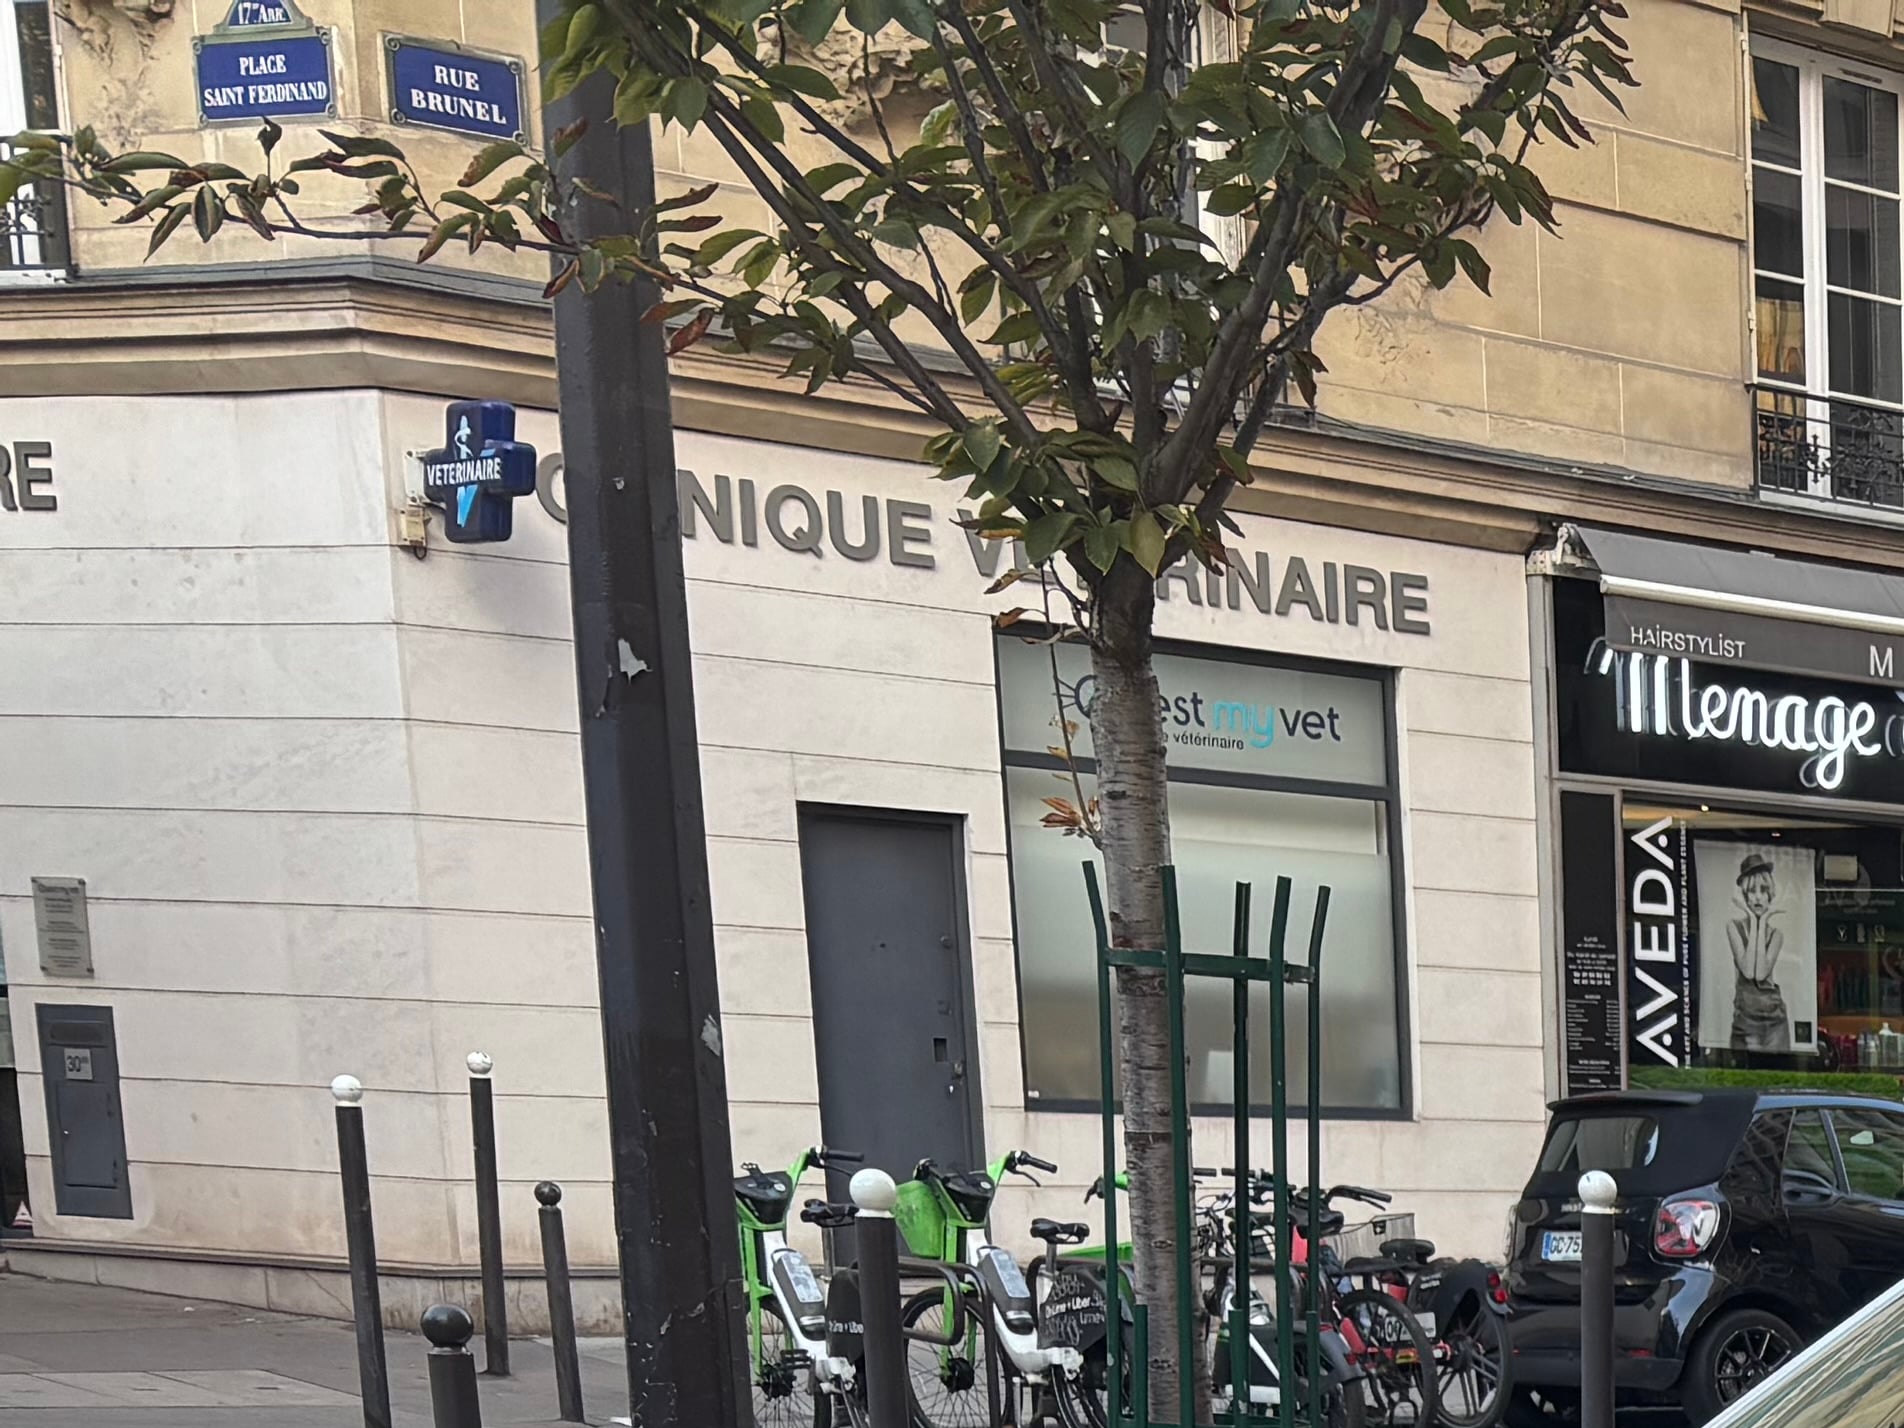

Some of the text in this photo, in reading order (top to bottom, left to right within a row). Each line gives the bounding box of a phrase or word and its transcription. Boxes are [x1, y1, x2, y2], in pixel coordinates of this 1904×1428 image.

[239, 54, 287, 76] PLACE
[434, 65, 480, 92] RUE
[204, 81, 328, 107] SAINT FERDINAND
[410, 88, 508, 125] BRUNEL
[426, 456, 503, 487] VETERINAIRE
[1212, 699, 1274, 750] my
[1279, 706, 1341, 742] vet
[1599, 644, 1882, 791] Menage
[1630, 815, 1680, 1069] AVEDA
